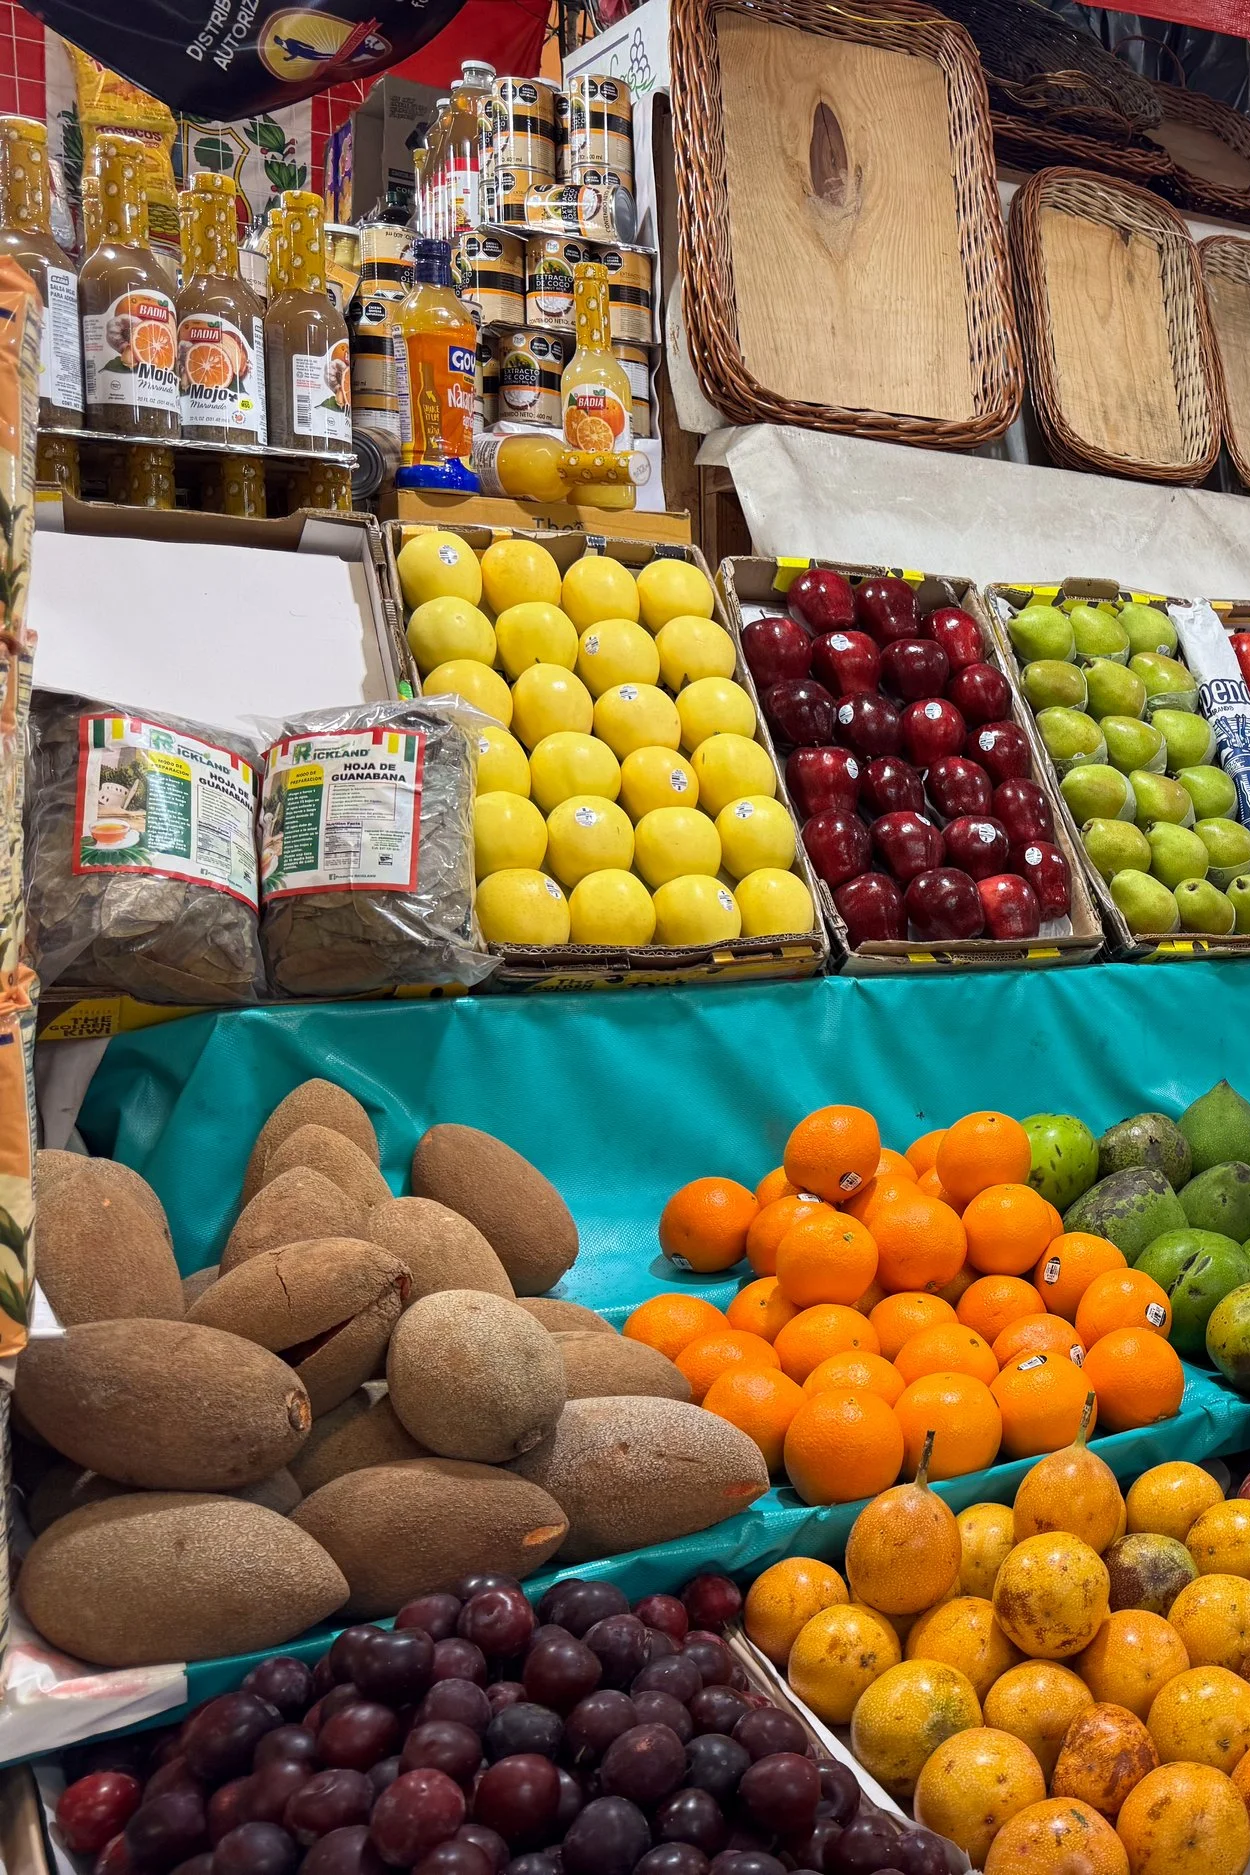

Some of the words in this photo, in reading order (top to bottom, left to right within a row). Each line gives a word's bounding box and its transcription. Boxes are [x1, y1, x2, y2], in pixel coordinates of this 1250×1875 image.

[140, 304, 167, 320] BADIA
[190, 327, 220, 340] BADIA
[452, 351, 476, 372] GOY
[138, 363, 174, 384] Mojo
[504, 368, 540, 376] EXTRACTO
[190, 384, 228, 402] Mojo
[578, 398, 604, 407] BADIA
[344, 762, 376, 771] HOJA
[380, 763, 396, 771] DE
[331, 772, 406, 782] GUANABANA
[210, 772, 237, 791] HOJA
[238, 786, 249, 800] DE
[199, 778, 254, 813] GUANABANA
[70, 1016, 112, 1024] THE
[49, 1023, 111, 1031] GOLDEN
